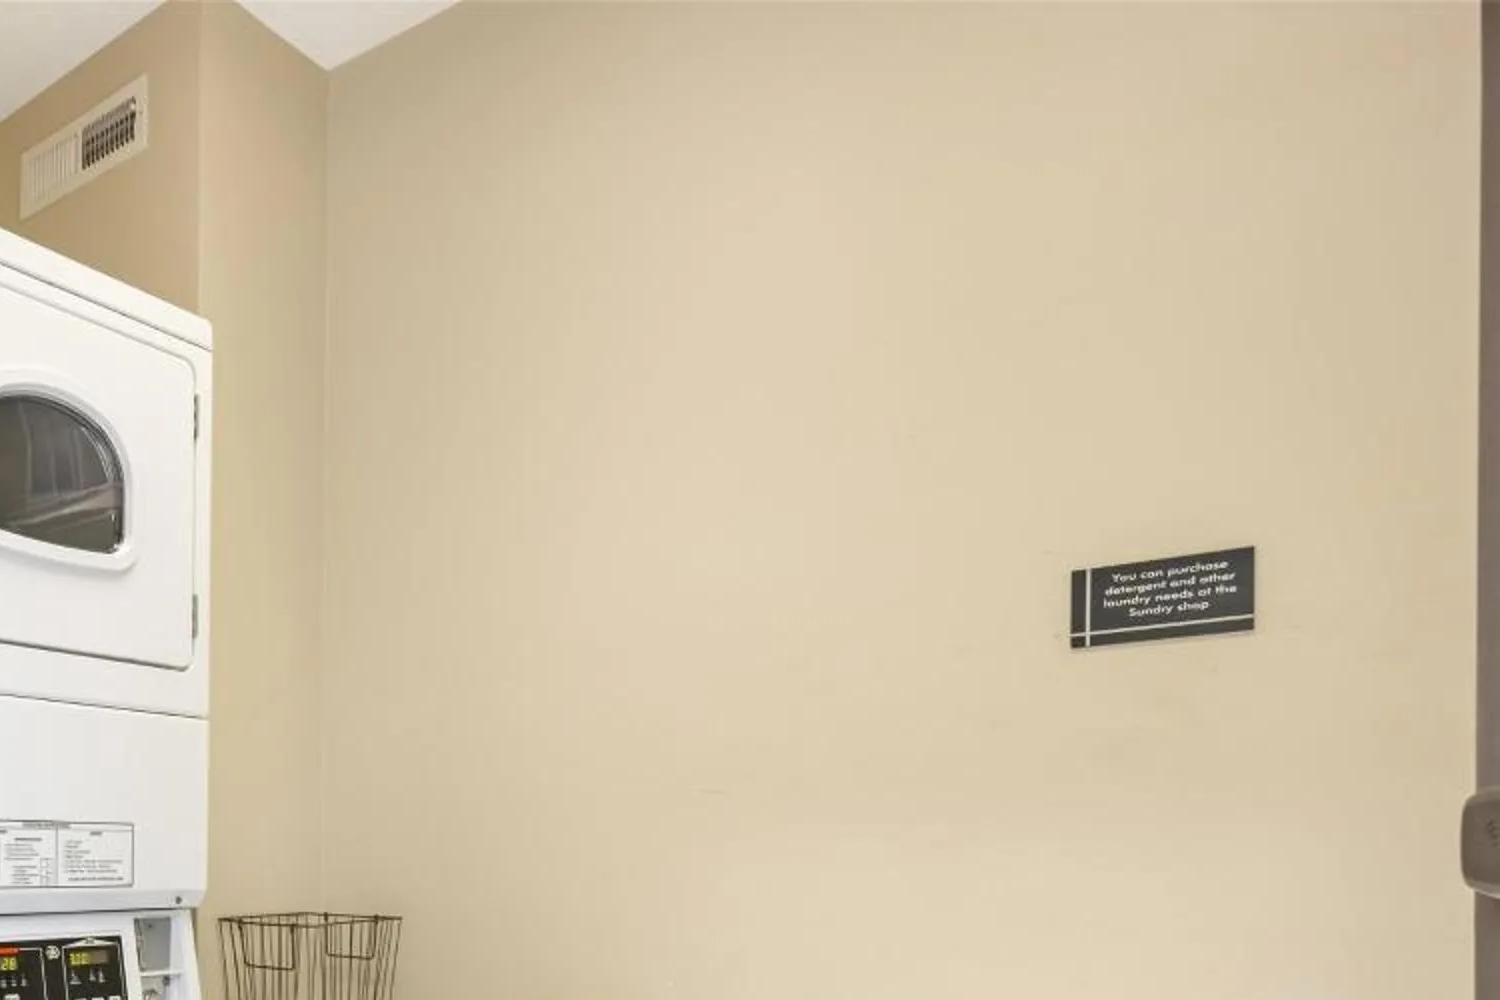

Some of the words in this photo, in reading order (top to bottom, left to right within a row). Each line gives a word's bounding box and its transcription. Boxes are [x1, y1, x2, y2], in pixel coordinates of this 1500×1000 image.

[1112, 571, 1137, 583] You
[1140, 568, 1164, 580] can
[1166, 561, 1229, 578] purchase
[1104, 580, 1168, 596] detergent
[1169, 575, 1197, 588] and
[1198, 572, 1236, 584] other
[1103, 595, 1152, 609] laundry
[1155, 589, 1195, 602] needs
[1215, 584, 1238, 594] the
[1128, 605, 1174, 617] Sundry
[1177, 600, 1210, 611] shop
